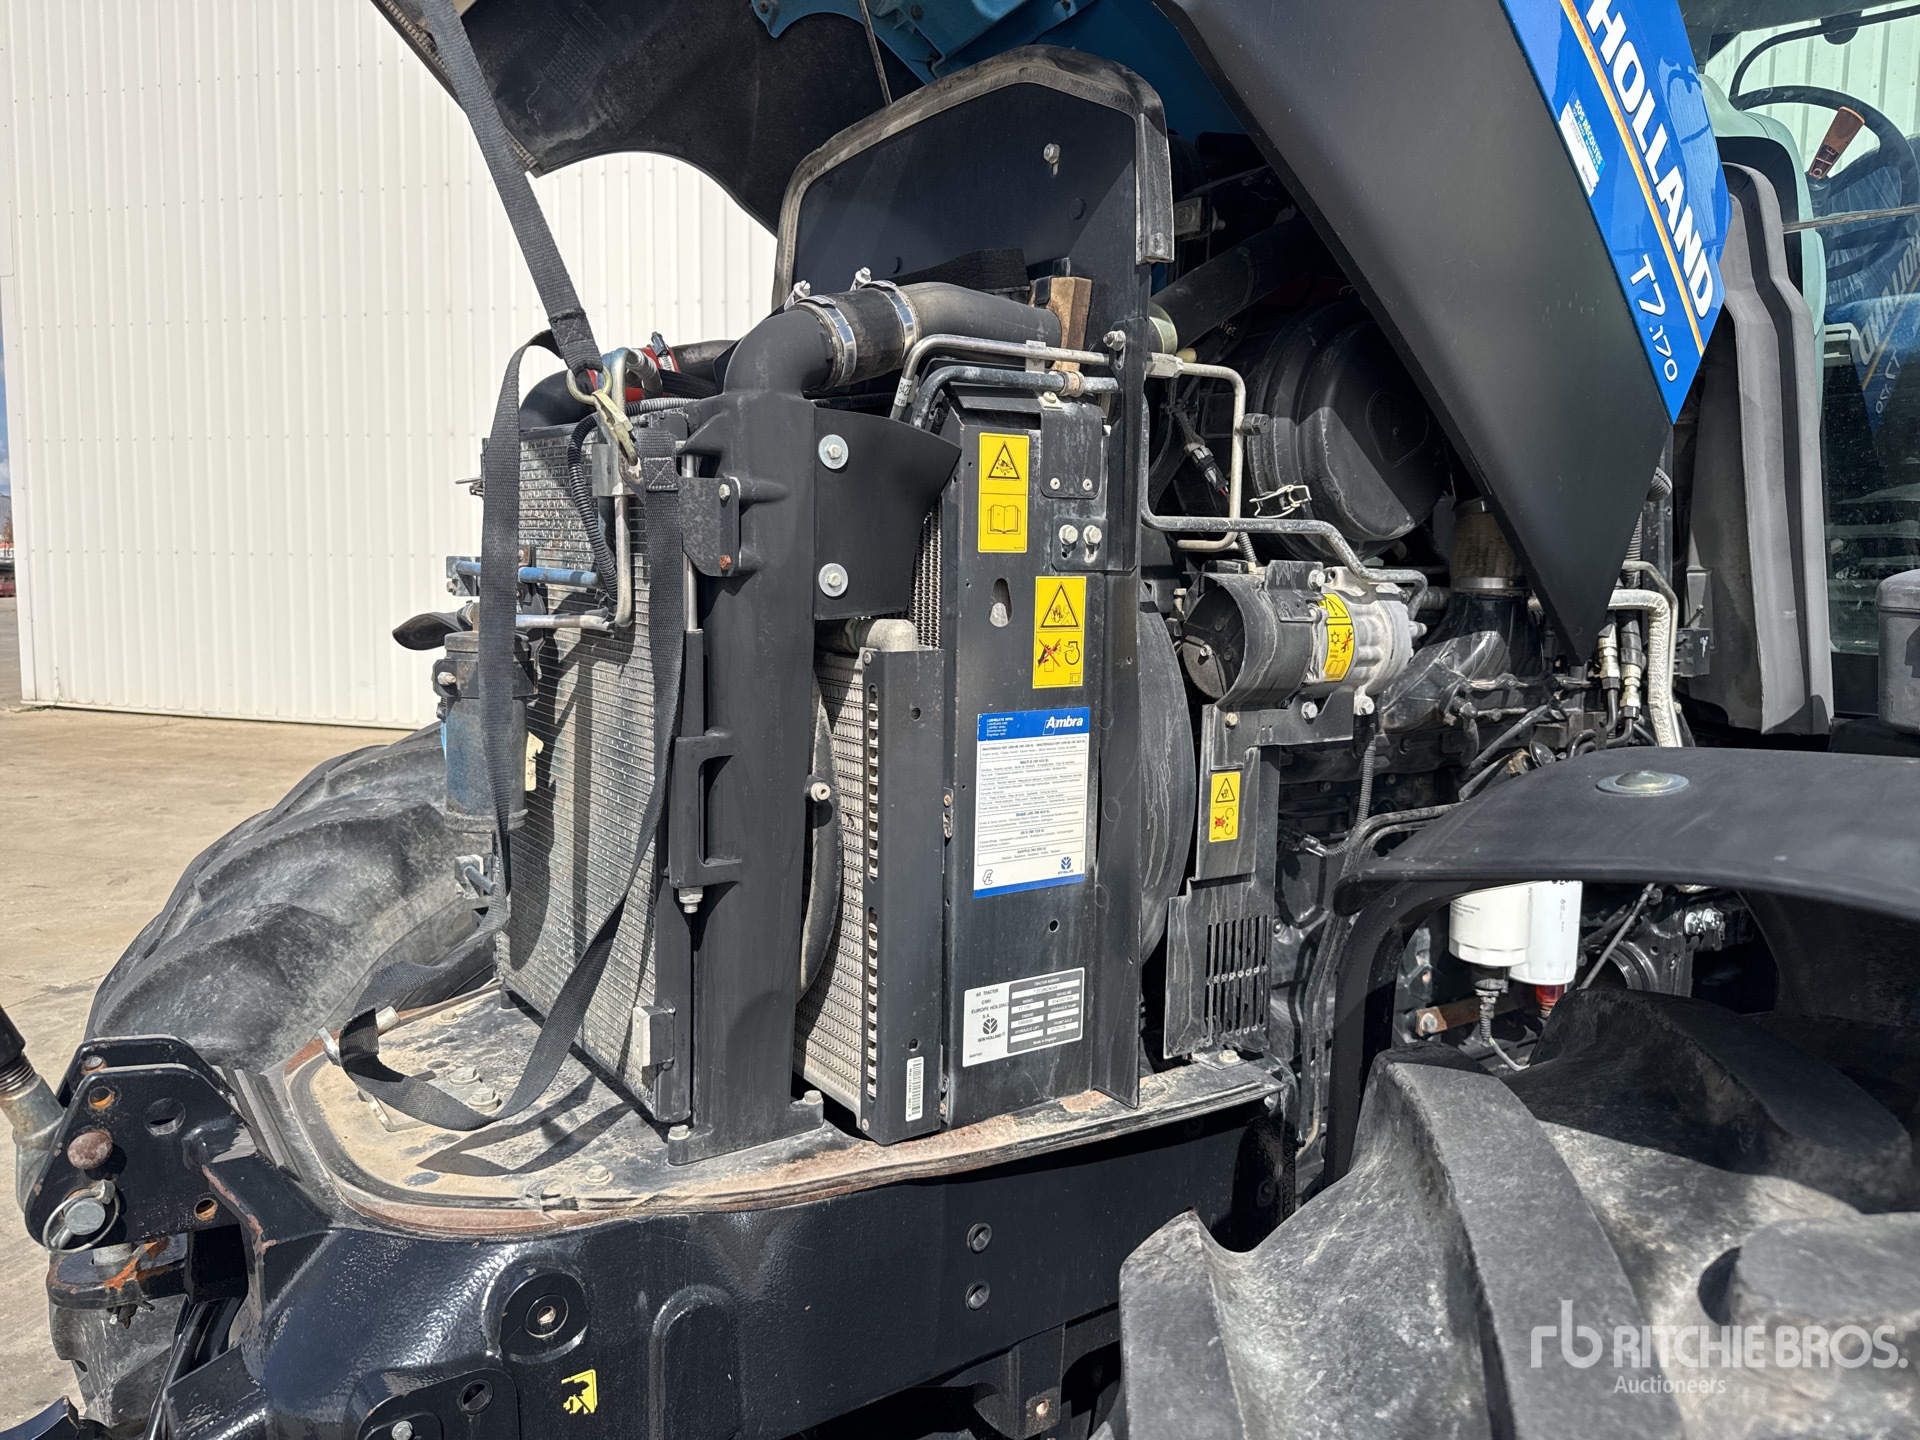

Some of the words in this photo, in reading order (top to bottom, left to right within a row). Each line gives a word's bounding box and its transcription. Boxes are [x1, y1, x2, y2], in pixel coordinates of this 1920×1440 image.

[1574, 99, 1585, 121] SOS
[1582, 118, 1603, 166] RÉCOLTES
[1586, 0, 1714, 319] HOLLAND
[1630, 253, 1679, 383] T7.170
[1046, 715, 1084, 729] Ambra
[971, 1006, 989, 1015] EUROPE
